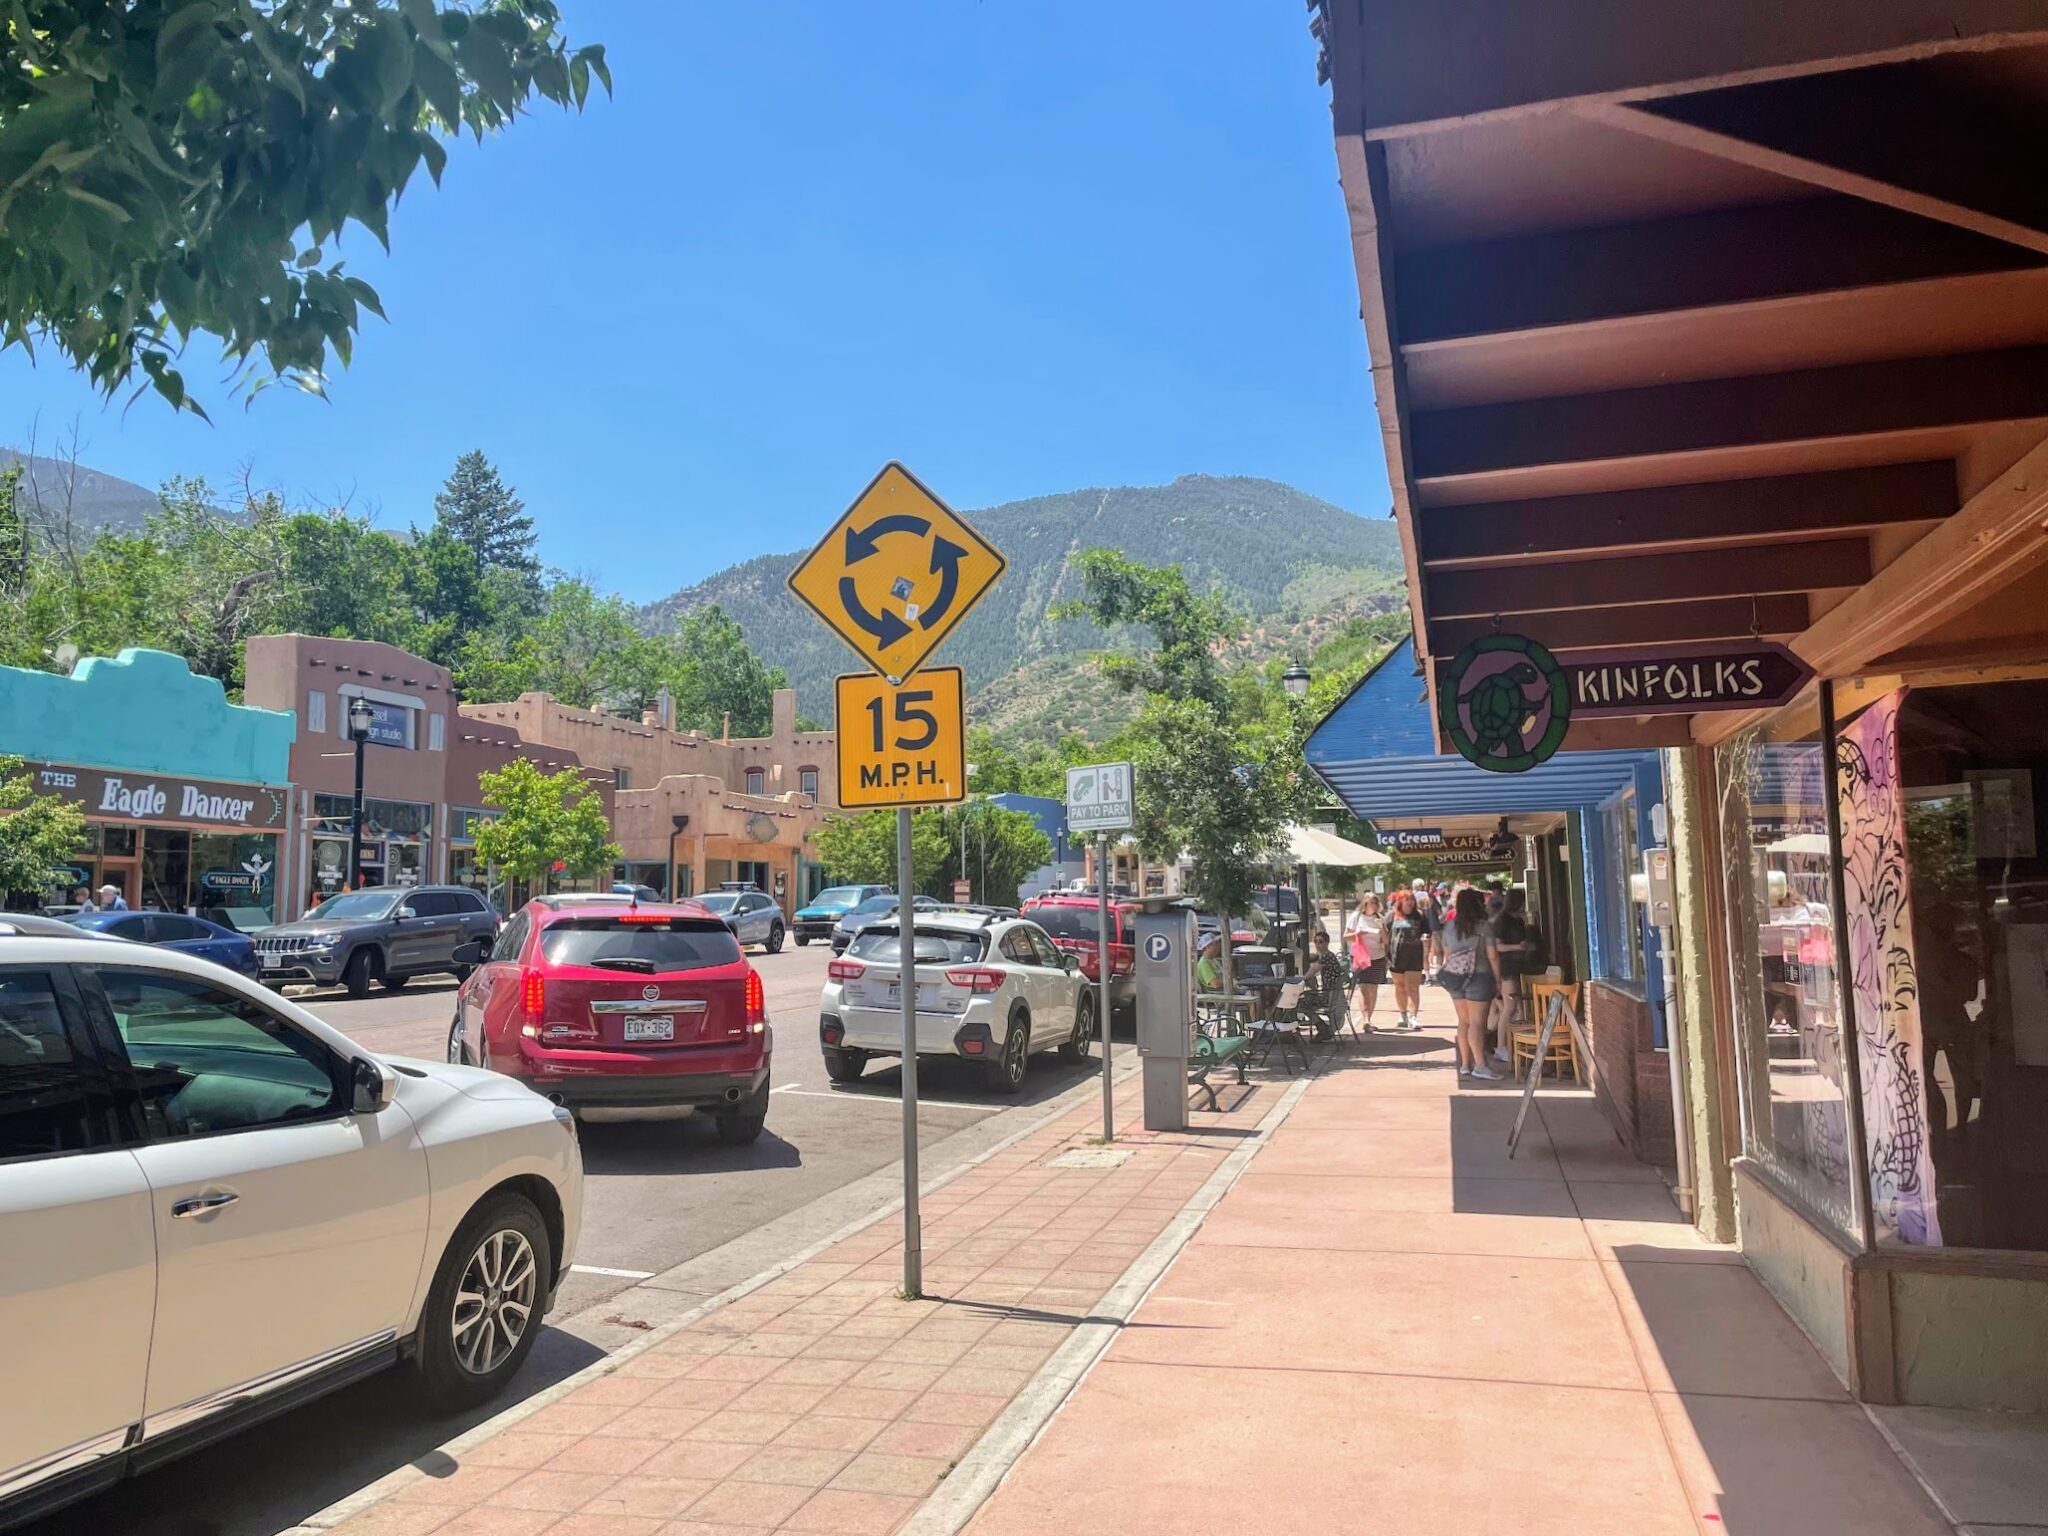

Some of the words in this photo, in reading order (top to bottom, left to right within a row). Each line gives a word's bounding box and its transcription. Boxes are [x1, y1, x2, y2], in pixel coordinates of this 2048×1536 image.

[1578, 660, 1763, 702] KINFOLKS
[866, 690, 938, 752] 15
[861, 760, 944, 788] M.P.H.
[41, 771, 77, 788] THE
[99, 778, 166, 818] Eagle
[179, 785, 254, 822] Dancer
[1071, 807, 1087, 819] PAY
[1089, 806, 1100, 817] TO
[1103, 804, 1127, 817] PARK
[1377, 833, 1395, 845] Ice
[1398, 832, 1441, 844] Cream
[1453, 836, 1480, 848] CAFE
[1436, 850, 1512, 863] SPORTSWR
[1151, 937, 1167, 959] P
